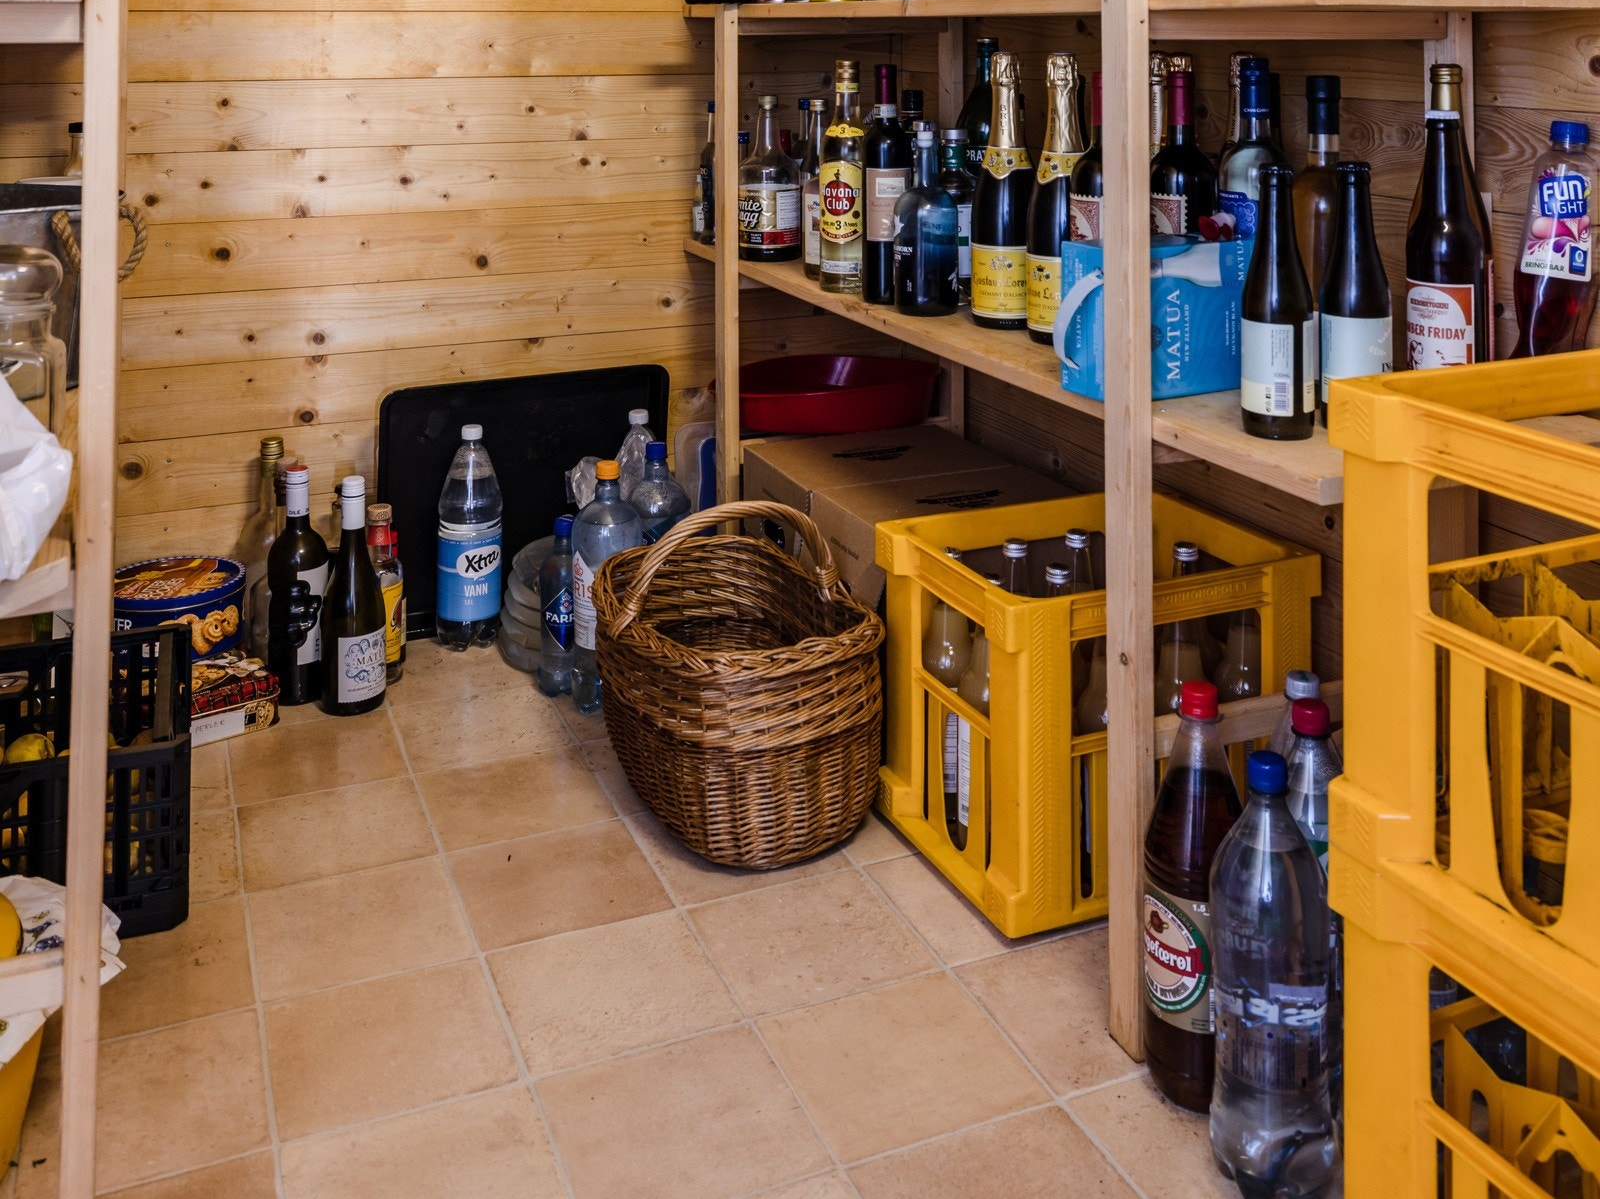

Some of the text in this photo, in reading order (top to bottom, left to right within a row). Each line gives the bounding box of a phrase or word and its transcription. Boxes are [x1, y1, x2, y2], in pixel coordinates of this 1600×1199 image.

[822, 185, 860, 198] Havana
[1542, 180, 1583, 202] FUN
[826, 199, 851, 210] Club
[1544, 201, 1584, 215] LIGHT
[1237, 238, 1245, 281] MATUA
[1166, 289, 1181, 382] MATUA
[1427, 326, 1467, 341] FRIDAY
[464, 550, 499, 573] Xtra
[464, 582, 488, 597] VANN
[1192, 903, 1206, 913] 1.5
